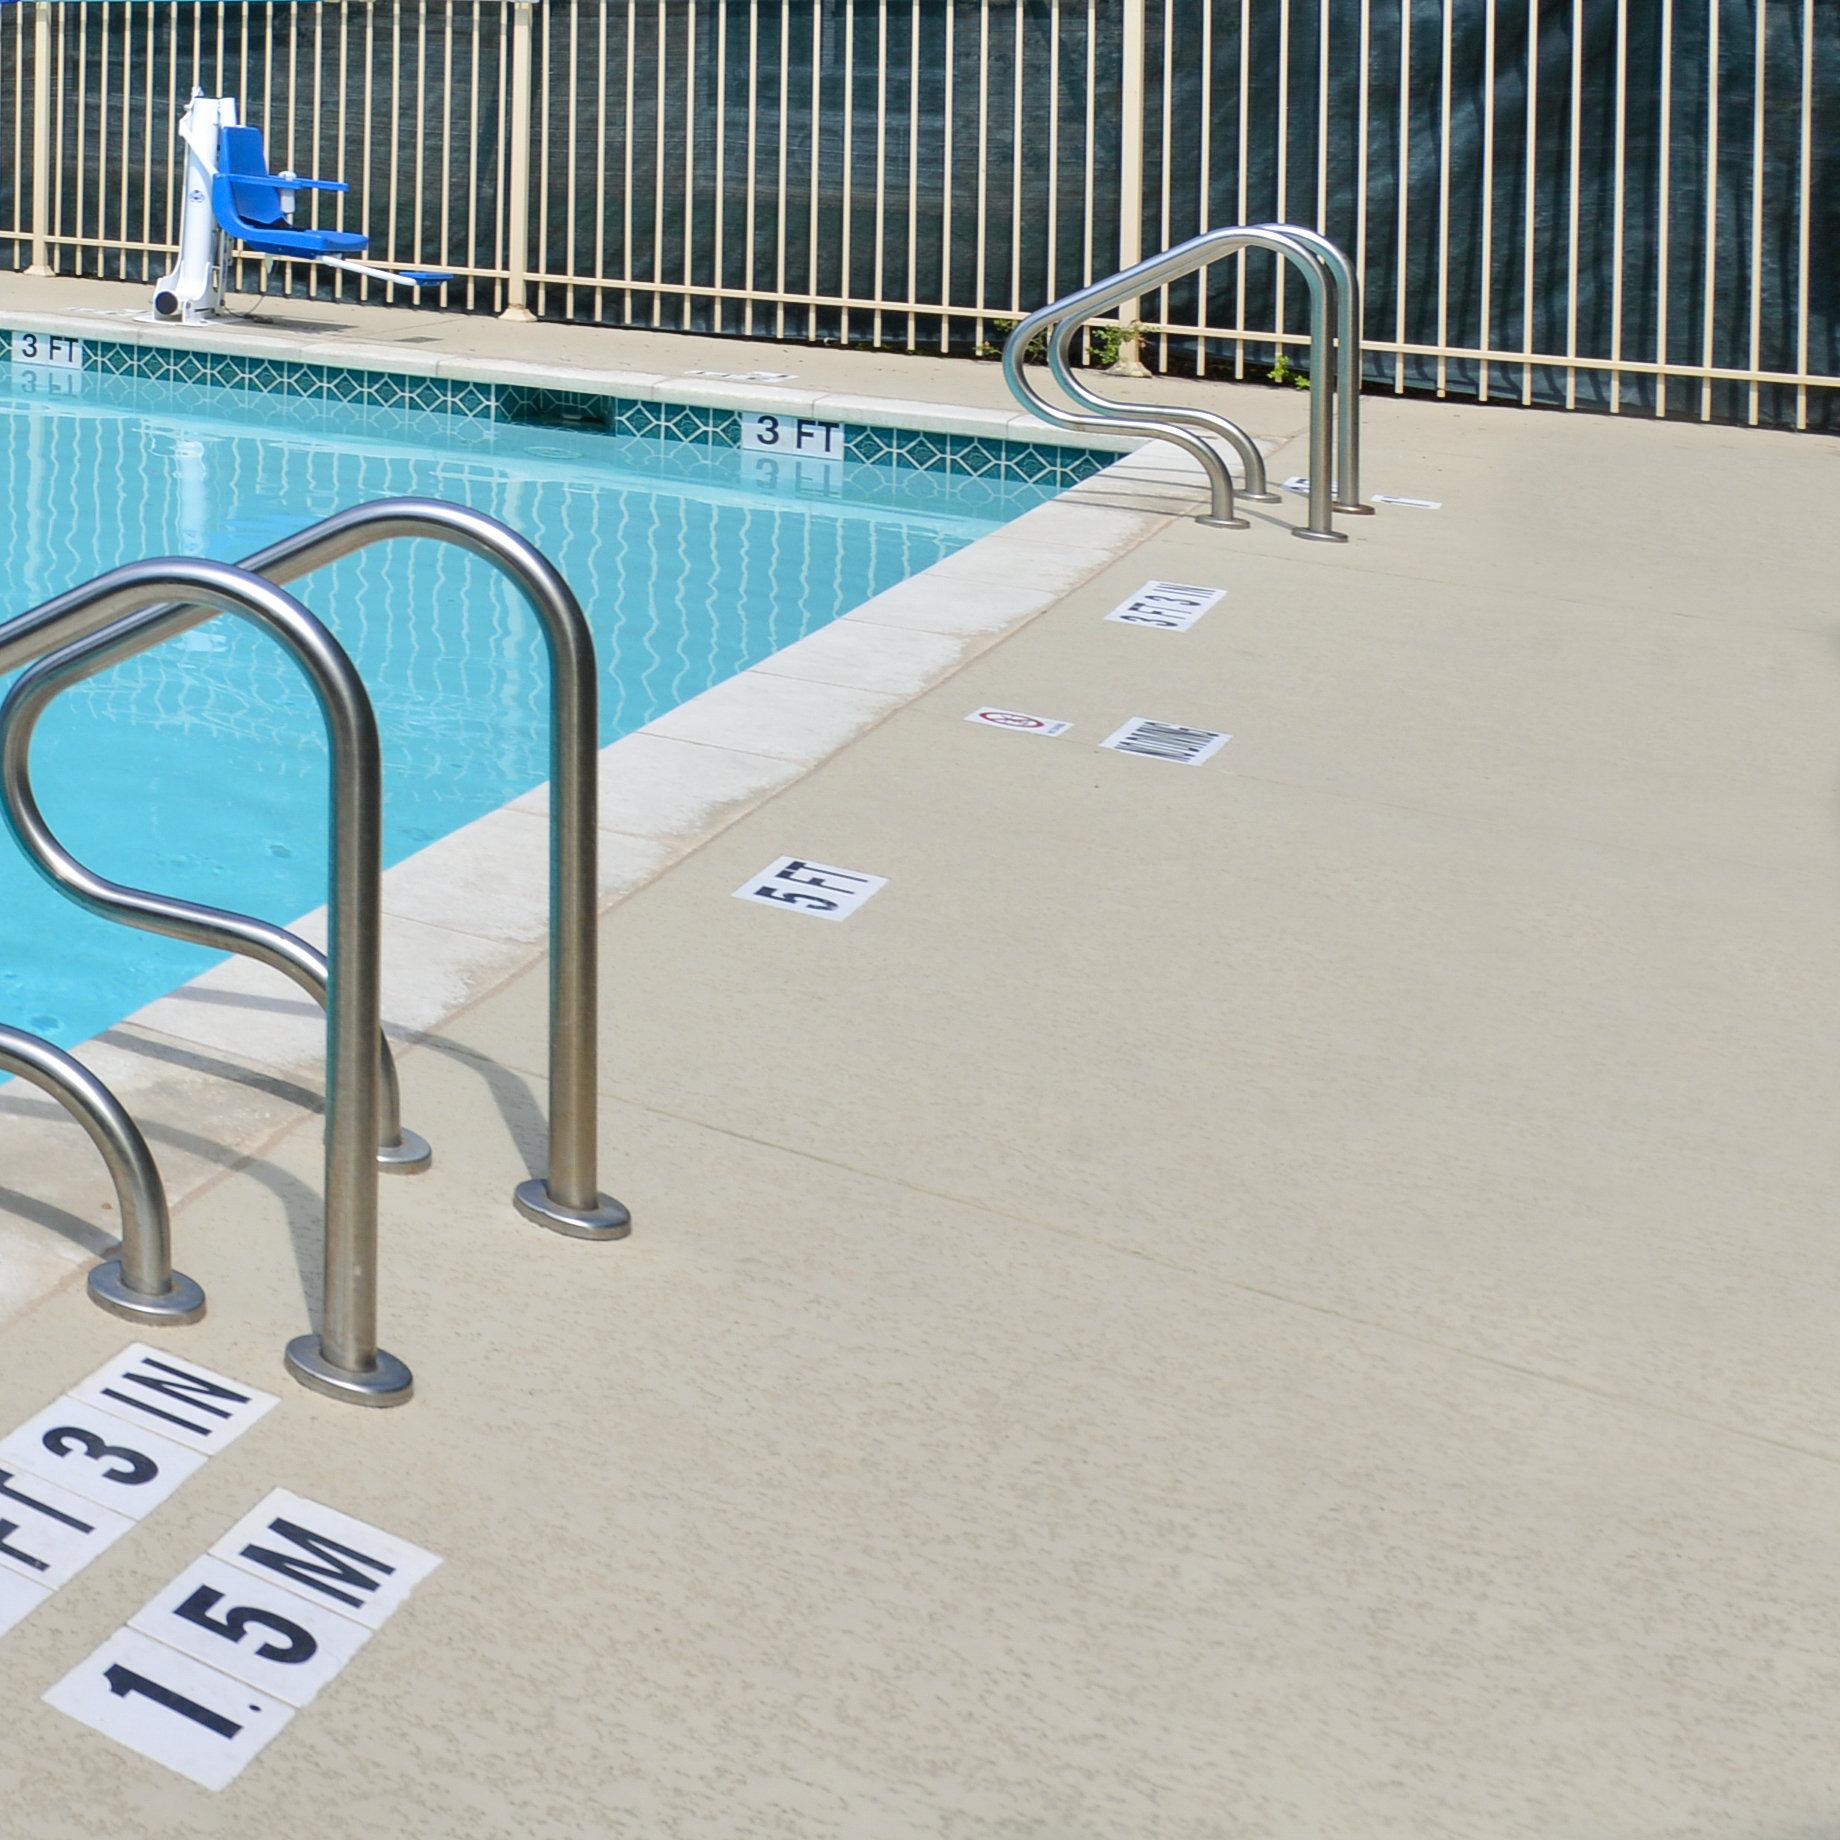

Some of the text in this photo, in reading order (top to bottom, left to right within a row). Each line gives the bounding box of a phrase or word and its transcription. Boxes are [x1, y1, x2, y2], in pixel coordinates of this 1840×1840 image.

[22, 333, 79, 363] 3 FT
[756, 415, 840, 453] 3 FT
[1153, 582, 1216, 598] IN
[1128, 602, 1192, 620] FT
[753, 860, 870, 911] 5 FT
[41, 1425, 159, 1486] 3
[100, 1356, 252, 1437] IN
[102, 1516, 396, 1740] 1.5 M
